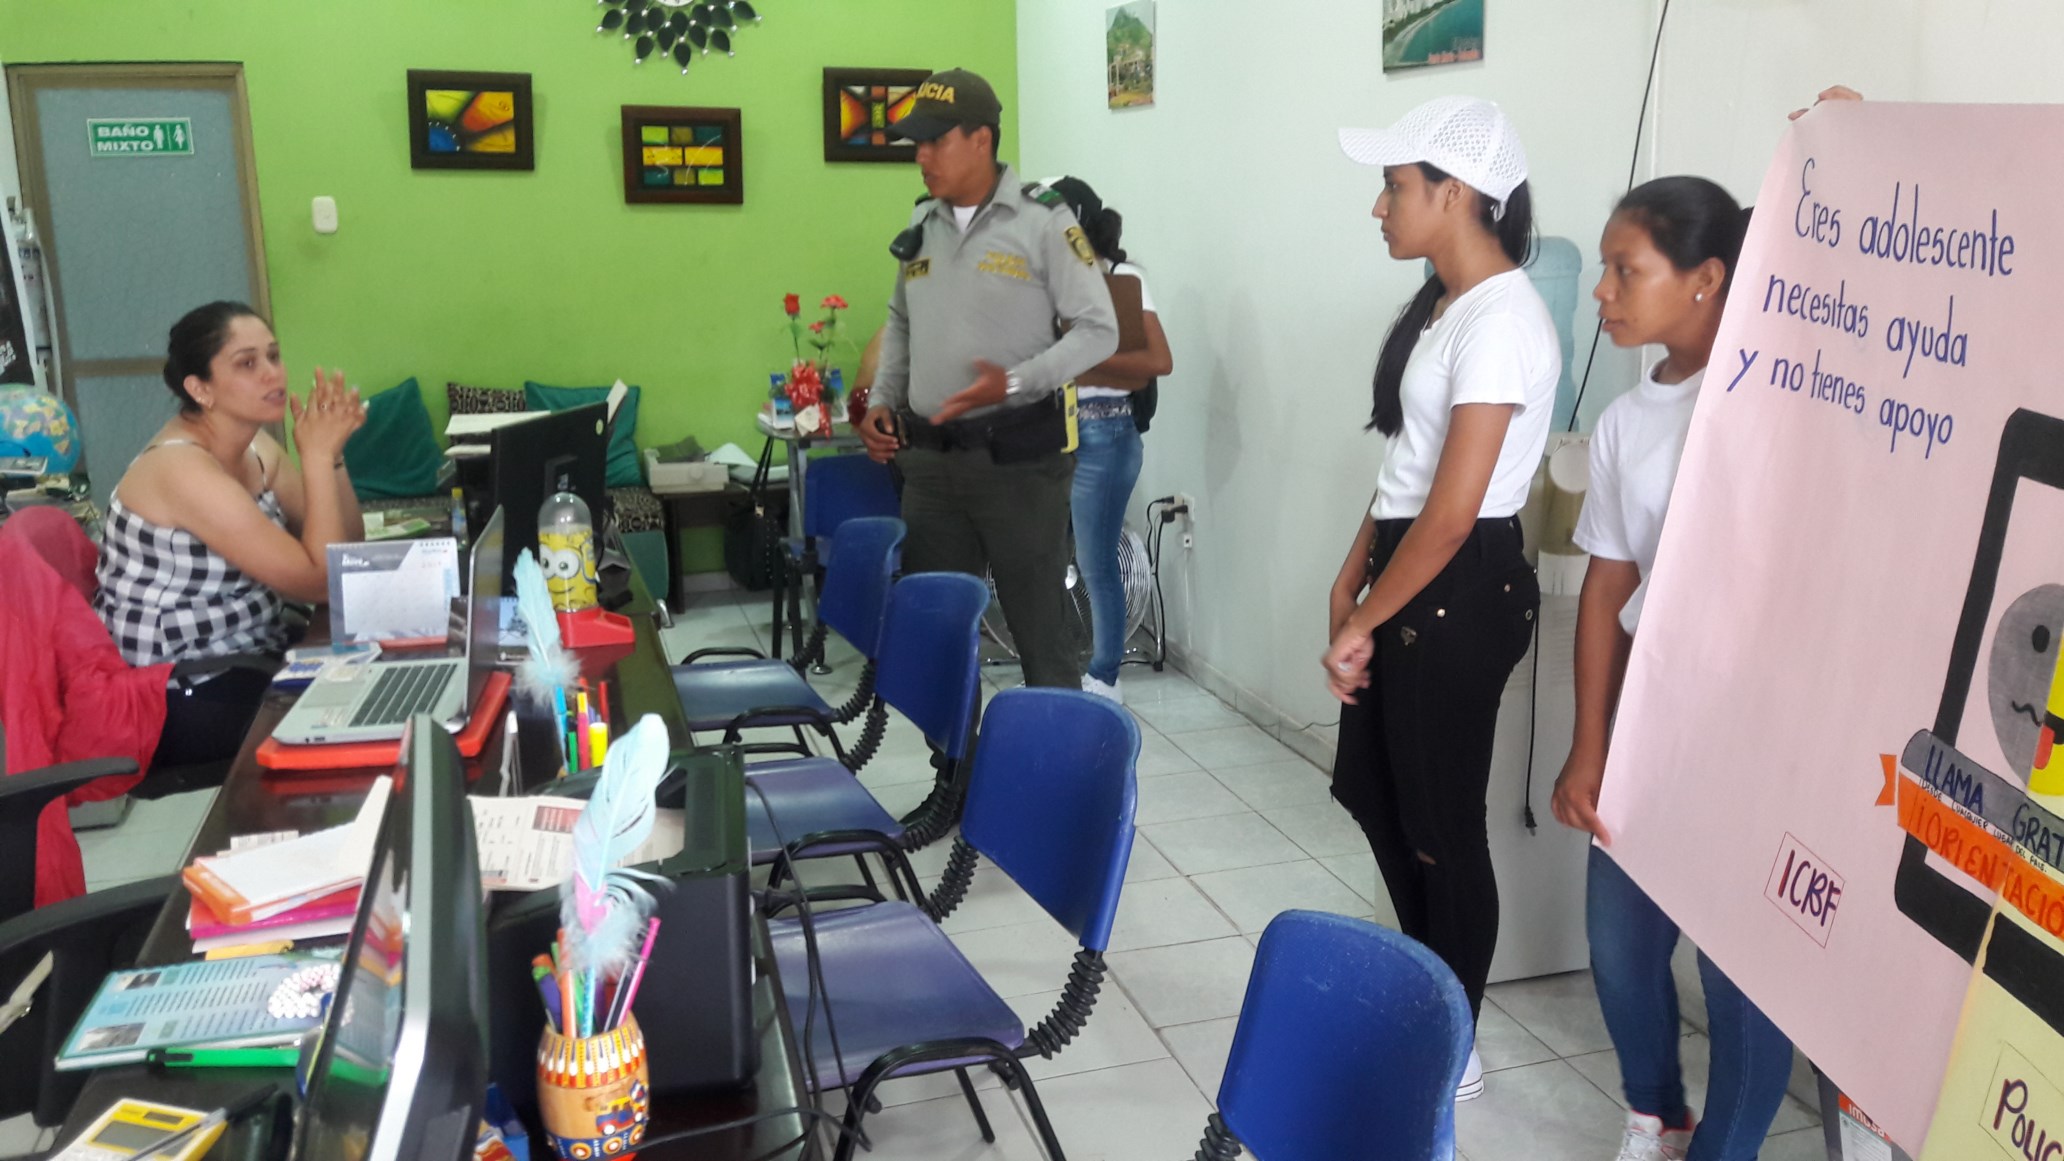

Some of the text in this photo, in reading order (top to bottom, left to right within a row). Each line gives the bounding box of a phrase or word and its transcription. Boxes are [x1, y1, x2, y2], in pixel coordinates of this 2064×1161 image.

[97, 124, 149, 137] BAÑO
[97, 140, 154, 151] MIXTO
[1795, 157, 2015, 277] Eres adolescente
[1762, 274, 1968, 379] necesitas ayuda
[1769, 357, 1804, 392] no
[1810, 348, 1865, 414] tienes
[1879, 397, 1954, 460] apoyo
[1924, 744, 1984, 816] LLAMA
[1777, 849, 1842, 928] ICBF
[2014, 845, 2027, 859] DEL
